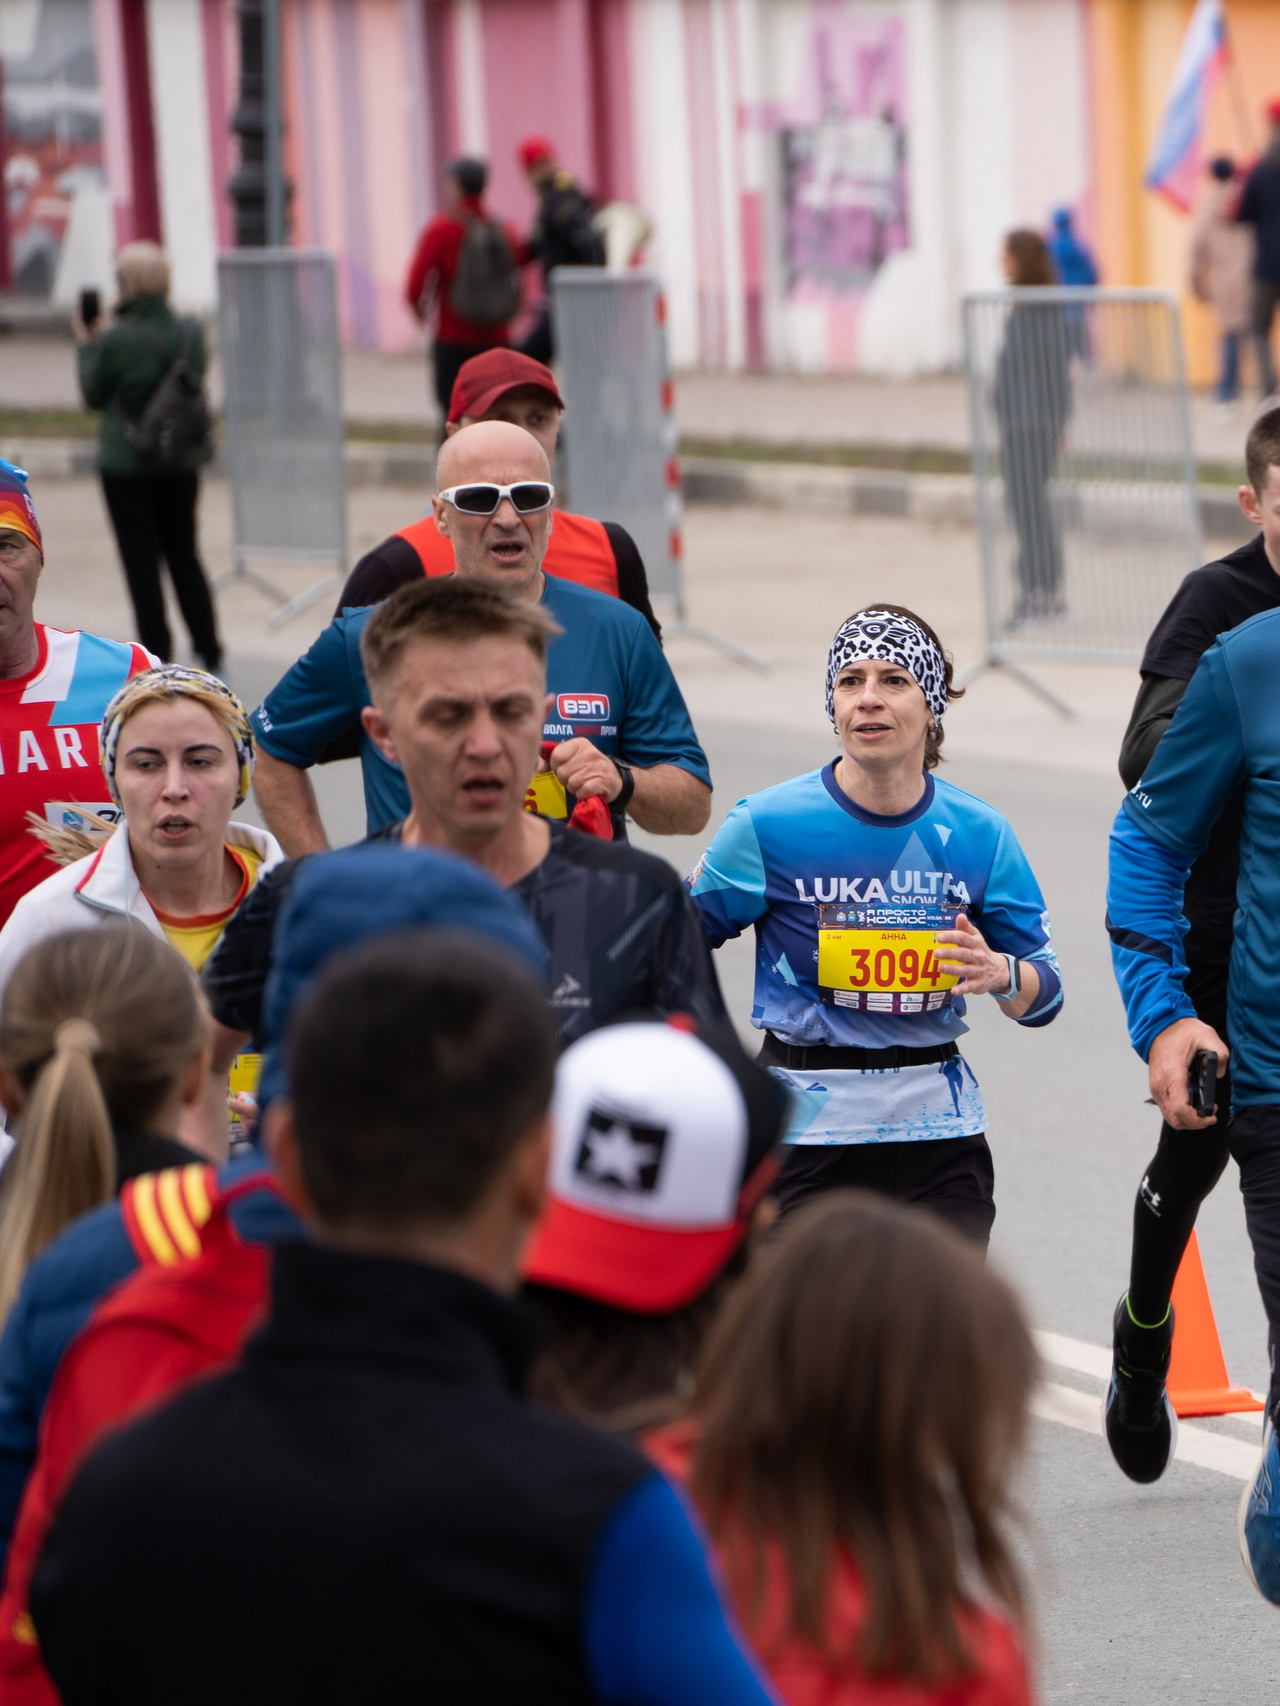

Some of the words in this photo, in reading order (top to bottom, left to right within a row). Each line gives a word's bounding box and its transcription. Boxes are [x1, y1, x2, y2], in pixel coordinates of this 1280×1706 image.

[563, 699, 605, 715] ВЭП
[0, 725, 104, 776] AR
[795, 877, 890, 903] LUKA
[890, 869, 972, 905] ULTRA
[866, 916, 927, 924] КОСМОС
[880, 933, 907, 941] АННА
[849, 948, 941, 988] 3094
